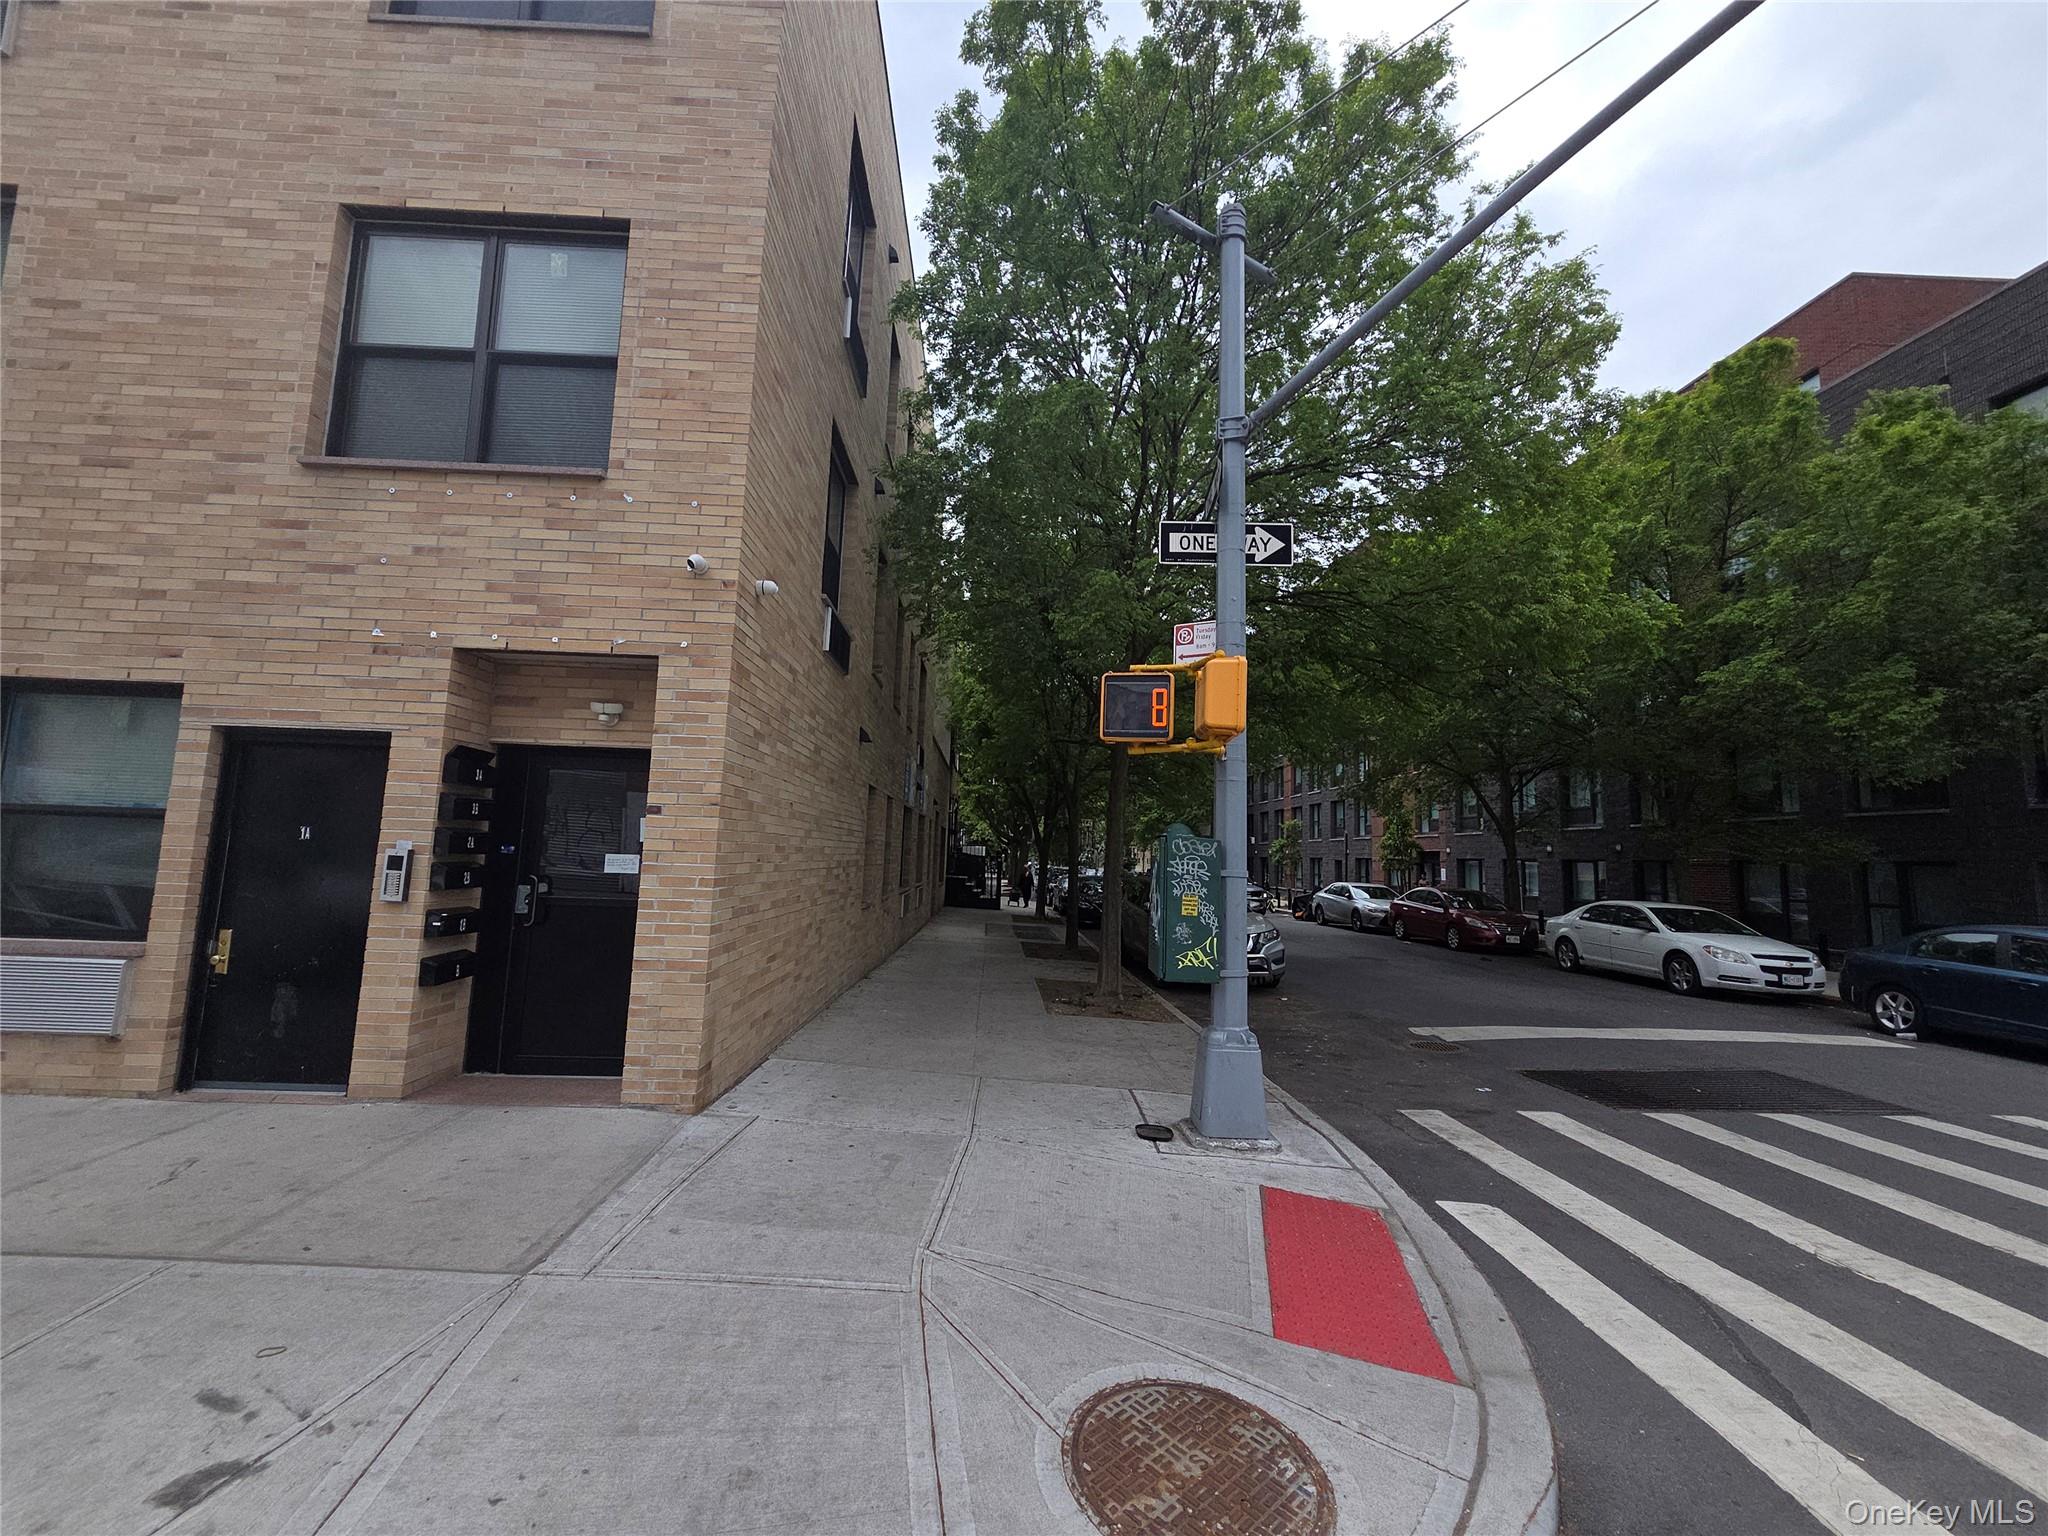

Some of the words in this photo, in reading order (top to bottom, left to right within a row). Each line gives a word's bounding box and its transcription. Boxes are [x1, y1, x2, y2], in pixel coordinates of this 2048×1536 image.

[1179, 535, 1216, 551] ONE
[1245, 536, 1272, 552] AY
[1152, 687, 1168, 727] 8
[299, 825, 310, 840] 1A
